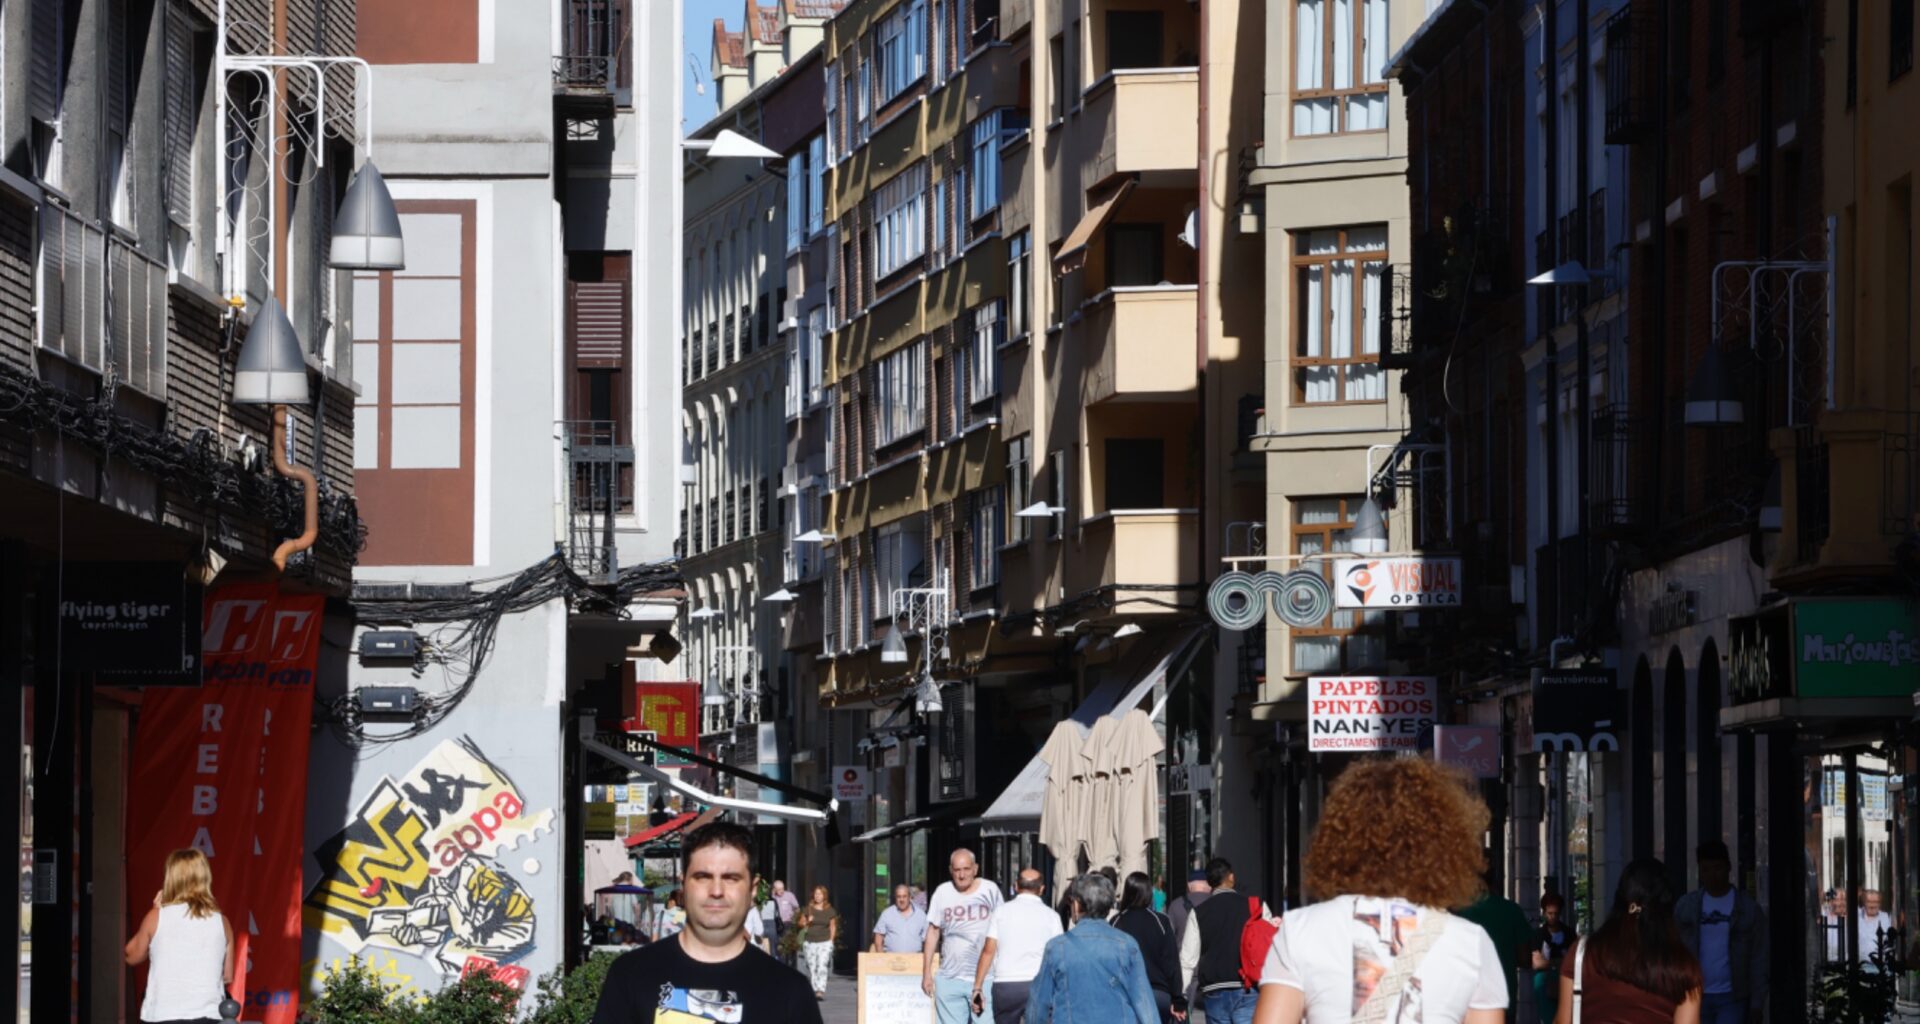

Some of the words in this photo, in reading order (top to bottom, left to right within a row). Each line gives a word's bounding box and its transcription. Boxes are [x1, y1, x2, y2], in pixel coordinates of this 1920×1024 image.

[1389, 562, 1456, 593] VISUAL
[1391, 592, 1457, 605] OPTICA
[60, 600, 117, 621] flying
[120, 600, 171, 621] tiger
[81, 620, 149, 632] copenhagen
[1319, 681, 1426, 696] PAPELES
[1312, 699, 1434, 715] PINTADOS
[1313, 719, 1433, 734] NAN-YES
[1313, 737, 1389, 748] DIRECTAMENTE
[429, 790, 523, 875] appa
[944, 904, 989, 923] BOLD
